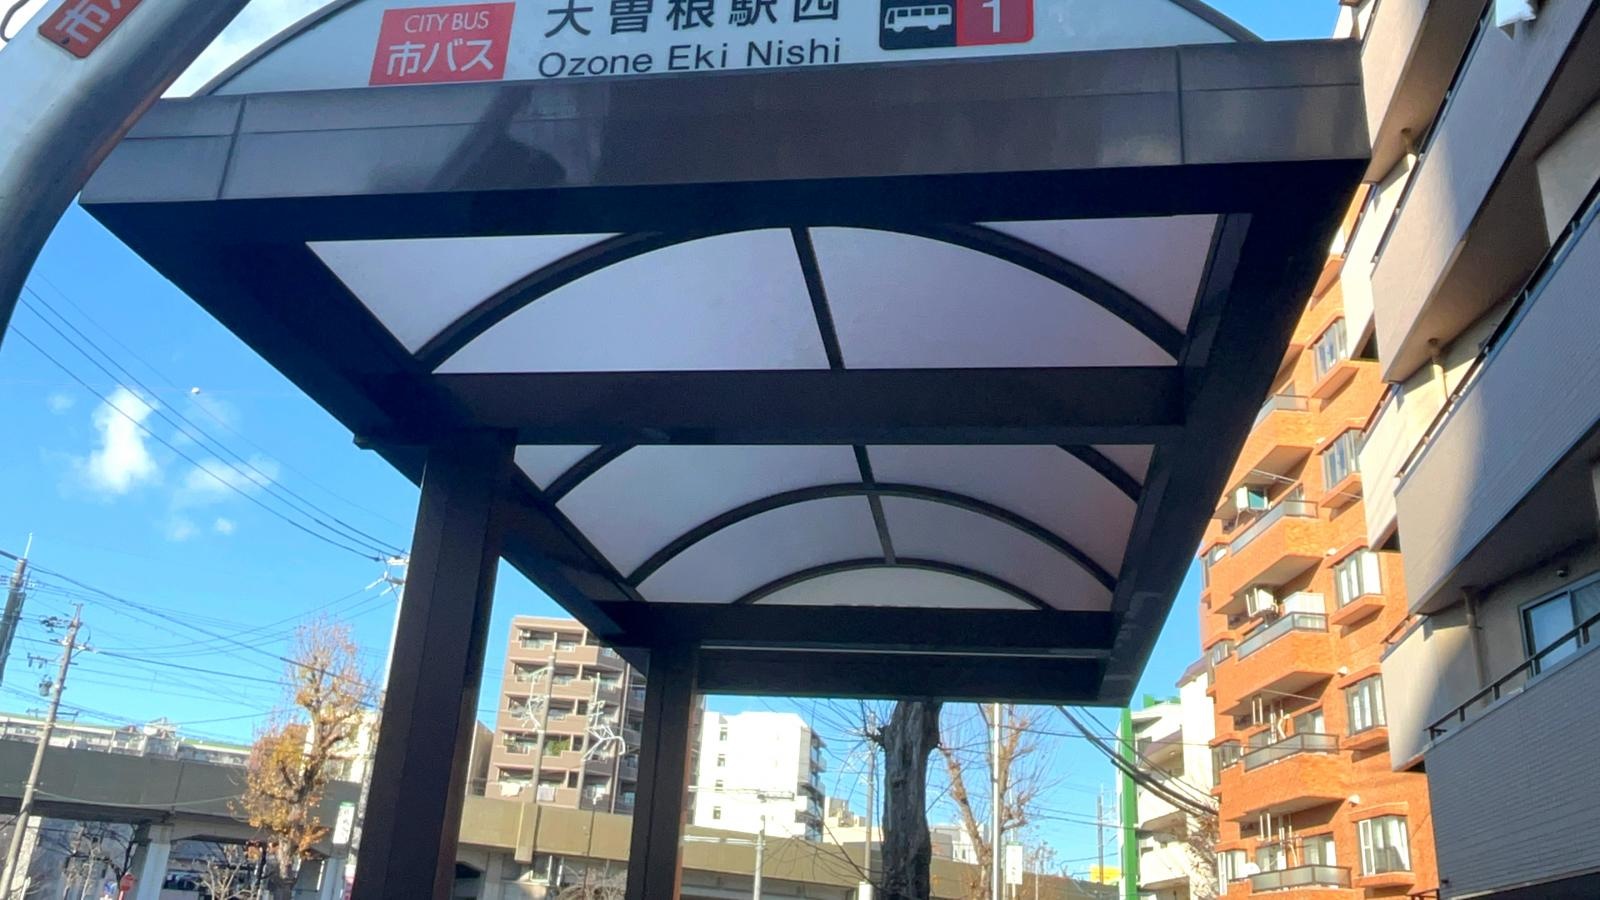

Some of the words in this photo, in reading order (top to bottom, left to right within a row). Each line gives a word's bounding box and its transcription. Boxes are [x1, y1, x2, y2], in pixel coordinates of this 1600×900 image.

[55, 0, 121, 44] 市
[404, 14, 449, 33] CITY
[451, 11, 490, 31] BUS
[982, 0, 1001, 33] 1
[386, 39, 494, 77] 市バス
[538, 52, 653, 78] Ozone
[668, 43, 728, 71] Eki
[746, 37, 840, 67] Nishi
